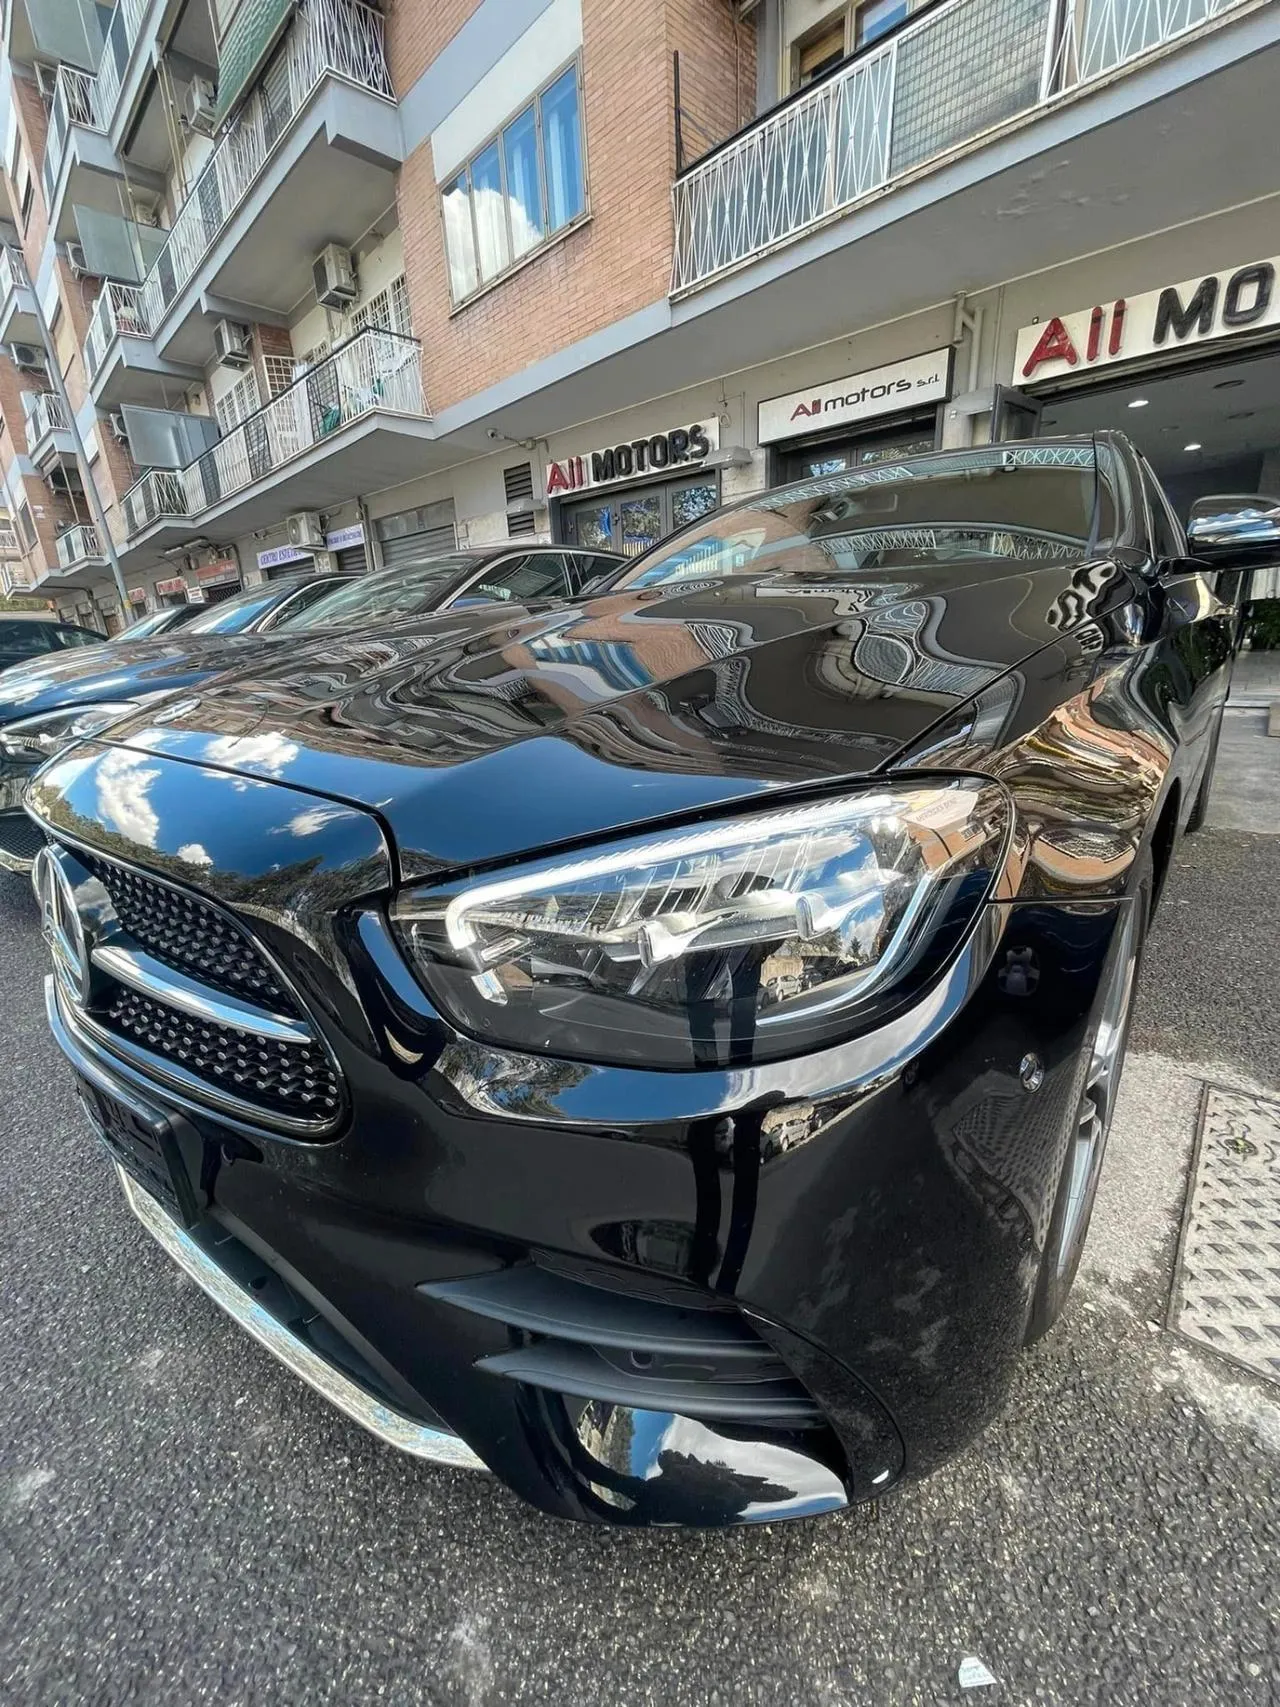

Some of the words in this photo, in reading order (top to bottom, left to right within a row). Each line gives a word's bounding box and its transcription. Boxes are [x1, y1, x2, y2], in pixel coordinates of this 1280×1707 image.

[1022, 298, 1126, 378] All
[790, 398, 822, 421] All
[824, 379, 912, 412] motors
[546, 455, 584, 495] All
[591, 423, 710, 482] MOTORS
